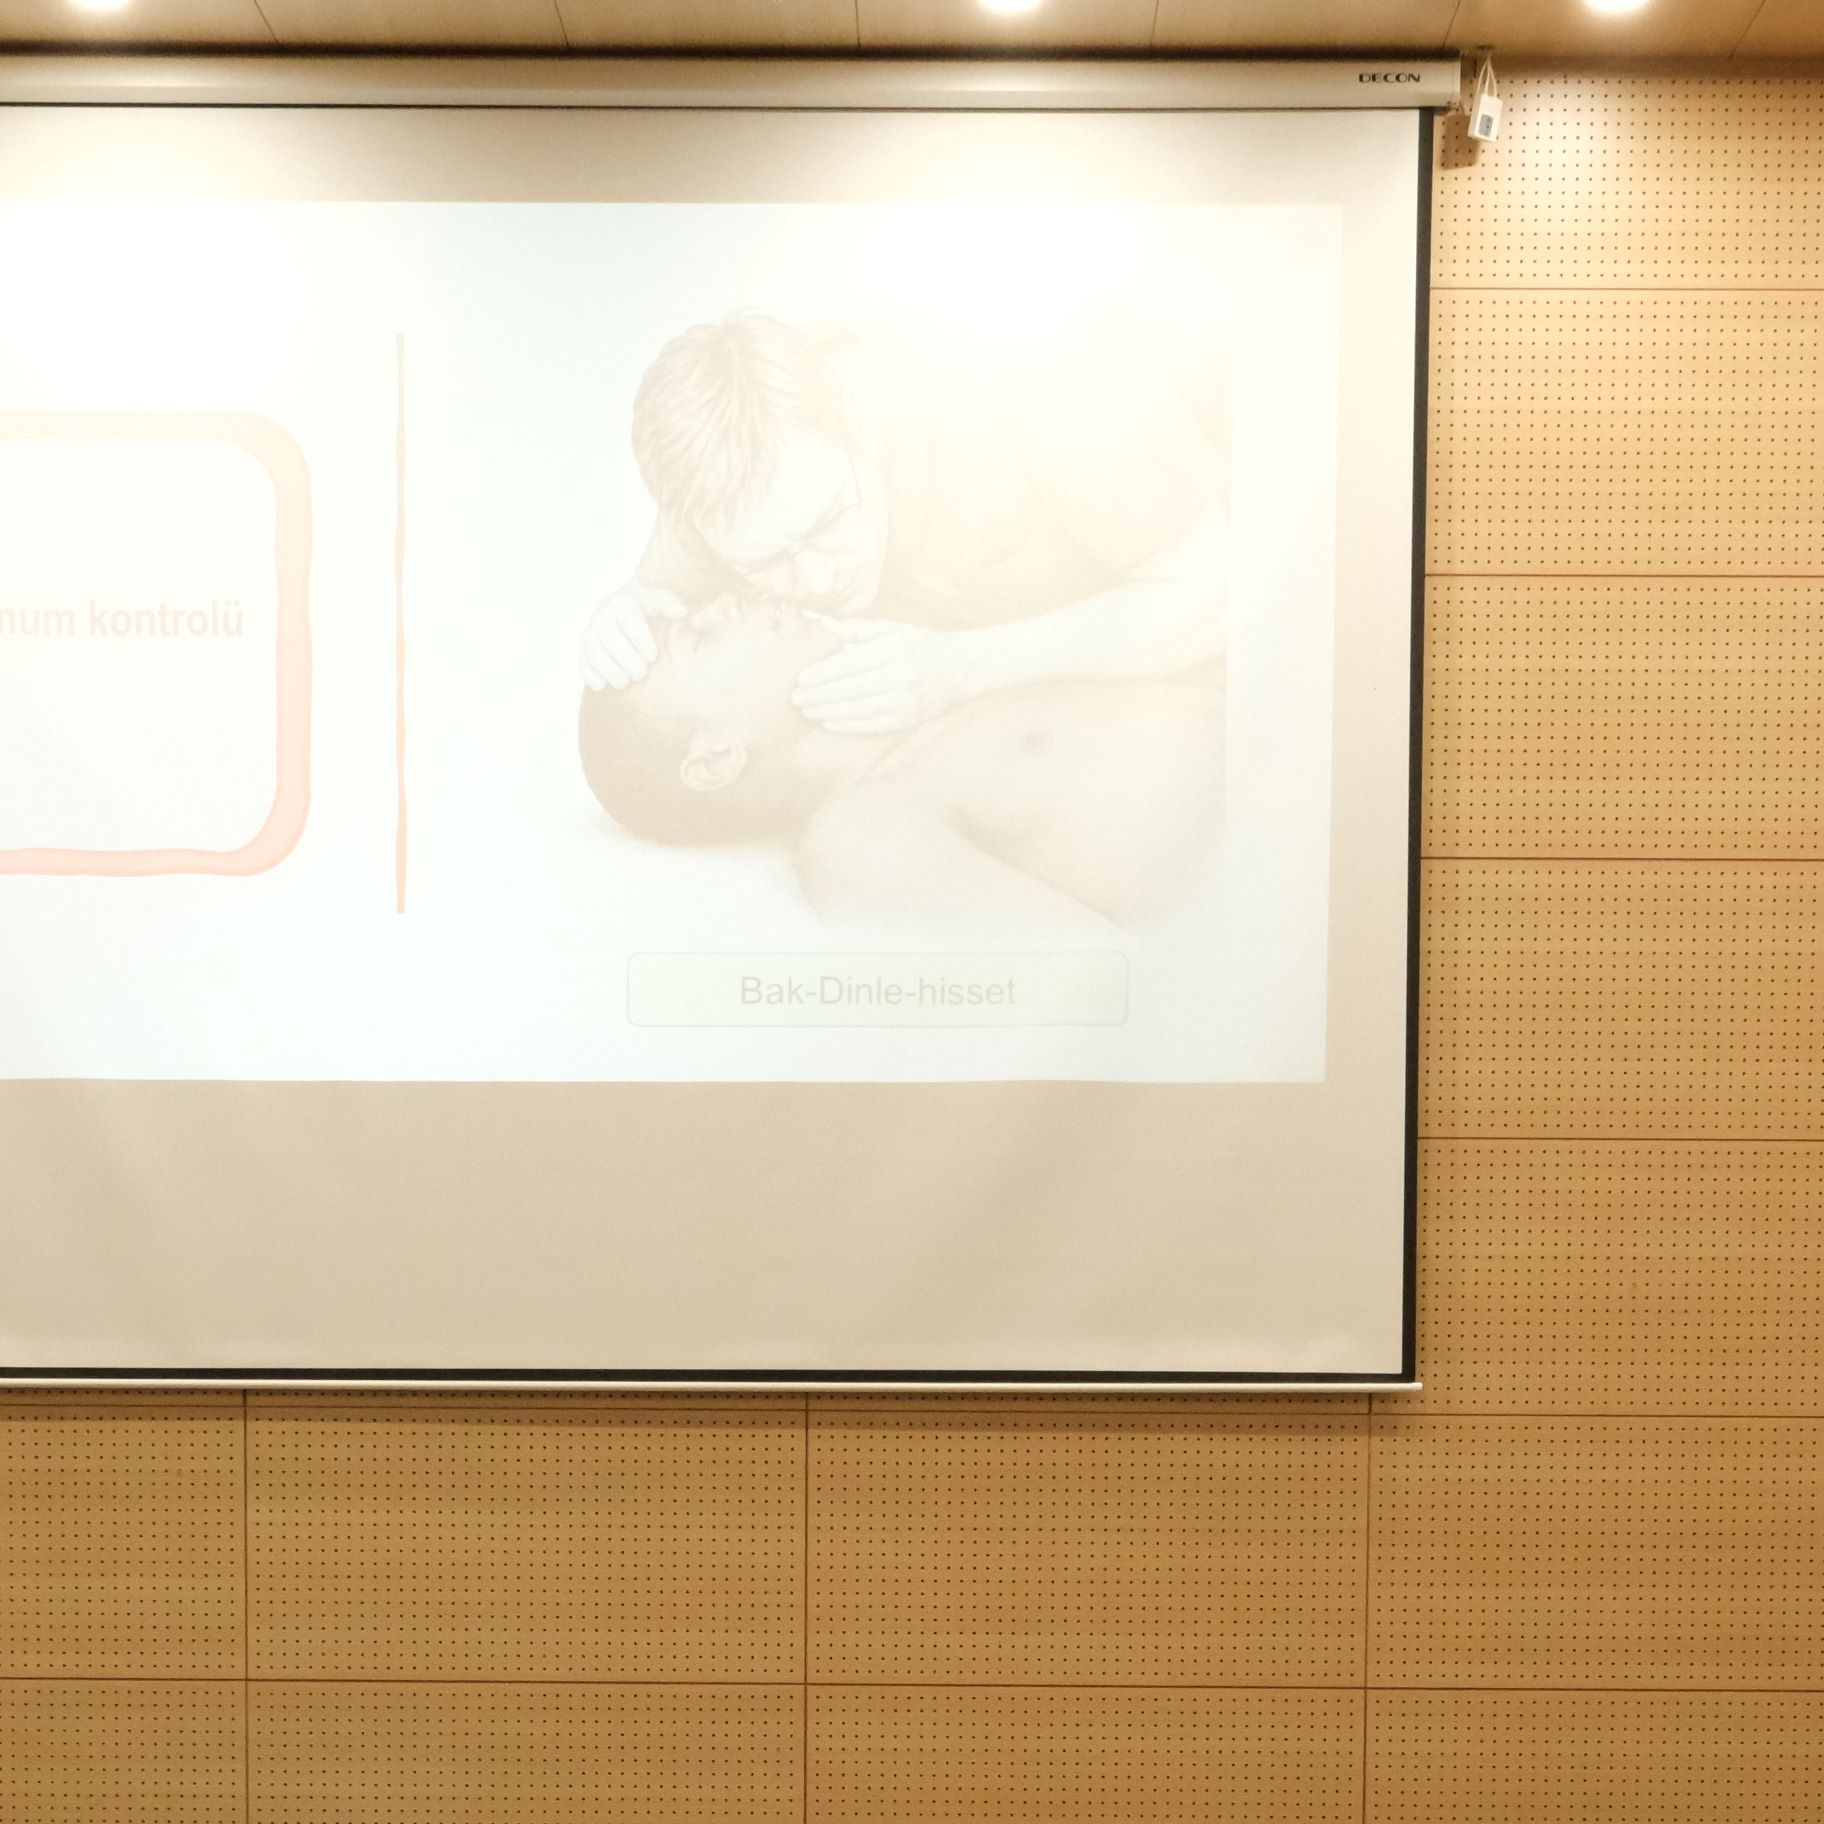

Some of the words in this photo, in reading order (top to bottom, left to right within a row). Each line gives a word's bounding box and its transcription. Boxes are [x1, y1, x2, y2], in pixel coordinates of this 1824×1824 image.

[1358, 72, 1421, 84] DECON
[88, 600, 243, 637] kontrolü
[740, 976, 1016, 1005] Bak-Dinle-hisset
